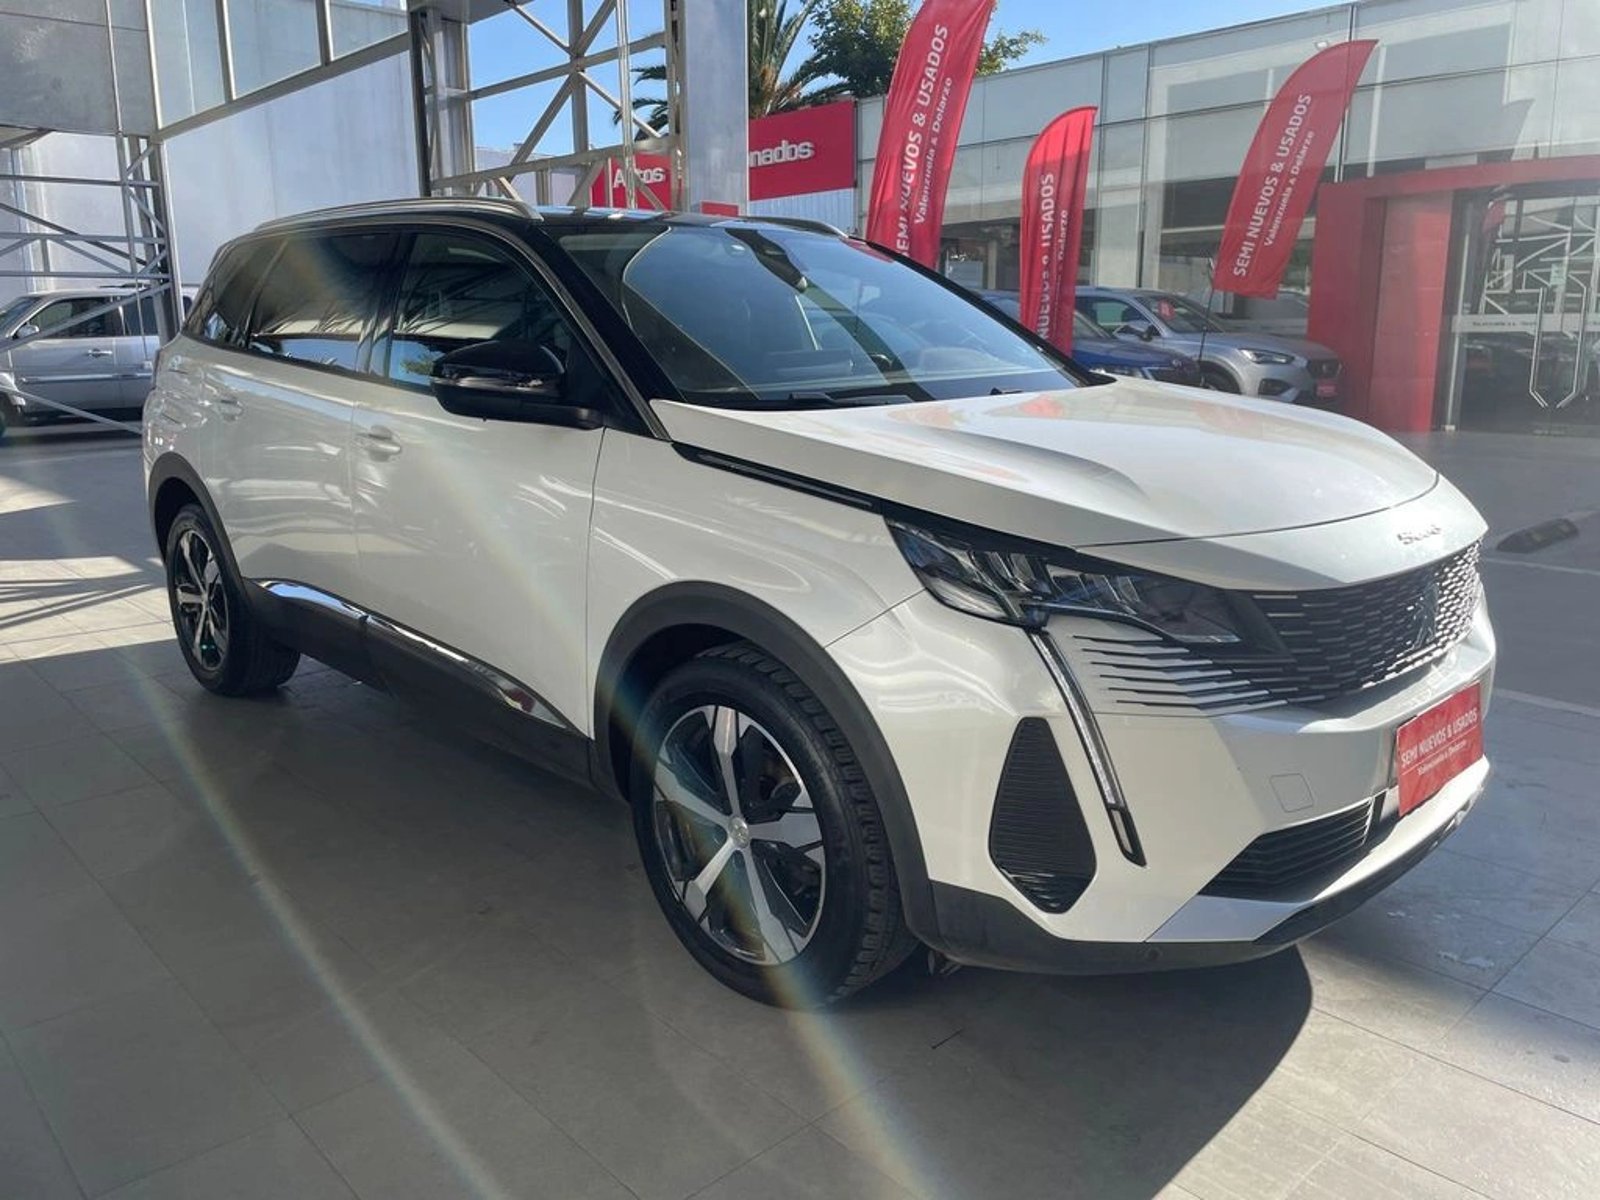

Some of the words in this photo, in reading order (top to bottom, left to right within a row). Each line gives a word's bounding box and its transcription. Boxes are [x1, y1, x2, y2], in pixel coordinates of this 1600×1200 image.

[917, 24, 948, 107] USADOS
[912, 112, 926, 128] &
[1276, 94, 1312, 157] USADOS
[900, 130, 922, 212] NUEVOS
[1270, 162, 1284, 173] &
[1246, 176, 1278, 238] NUEVOS
[896, 217, 910, 257] EMI
[1233, 241, 1256, 277] SEMI
